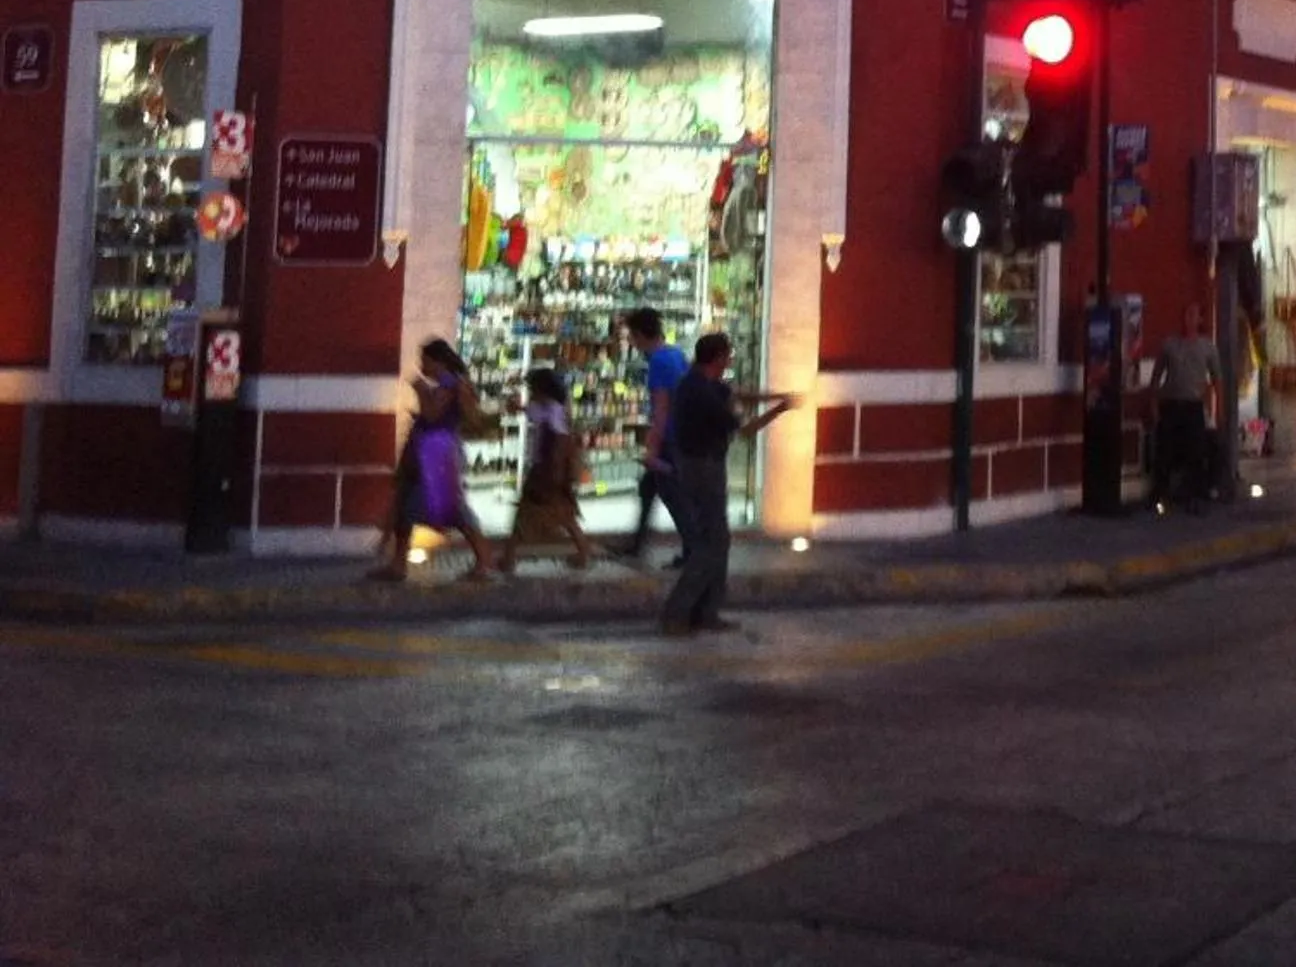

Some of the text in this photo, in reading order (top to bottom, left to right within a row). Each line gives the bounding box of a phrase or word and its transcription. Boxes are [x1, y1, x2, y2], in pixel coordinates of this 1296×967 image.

[300, 146, 360, 164] San Juan
[297, 172, 356, 190] Catedral
